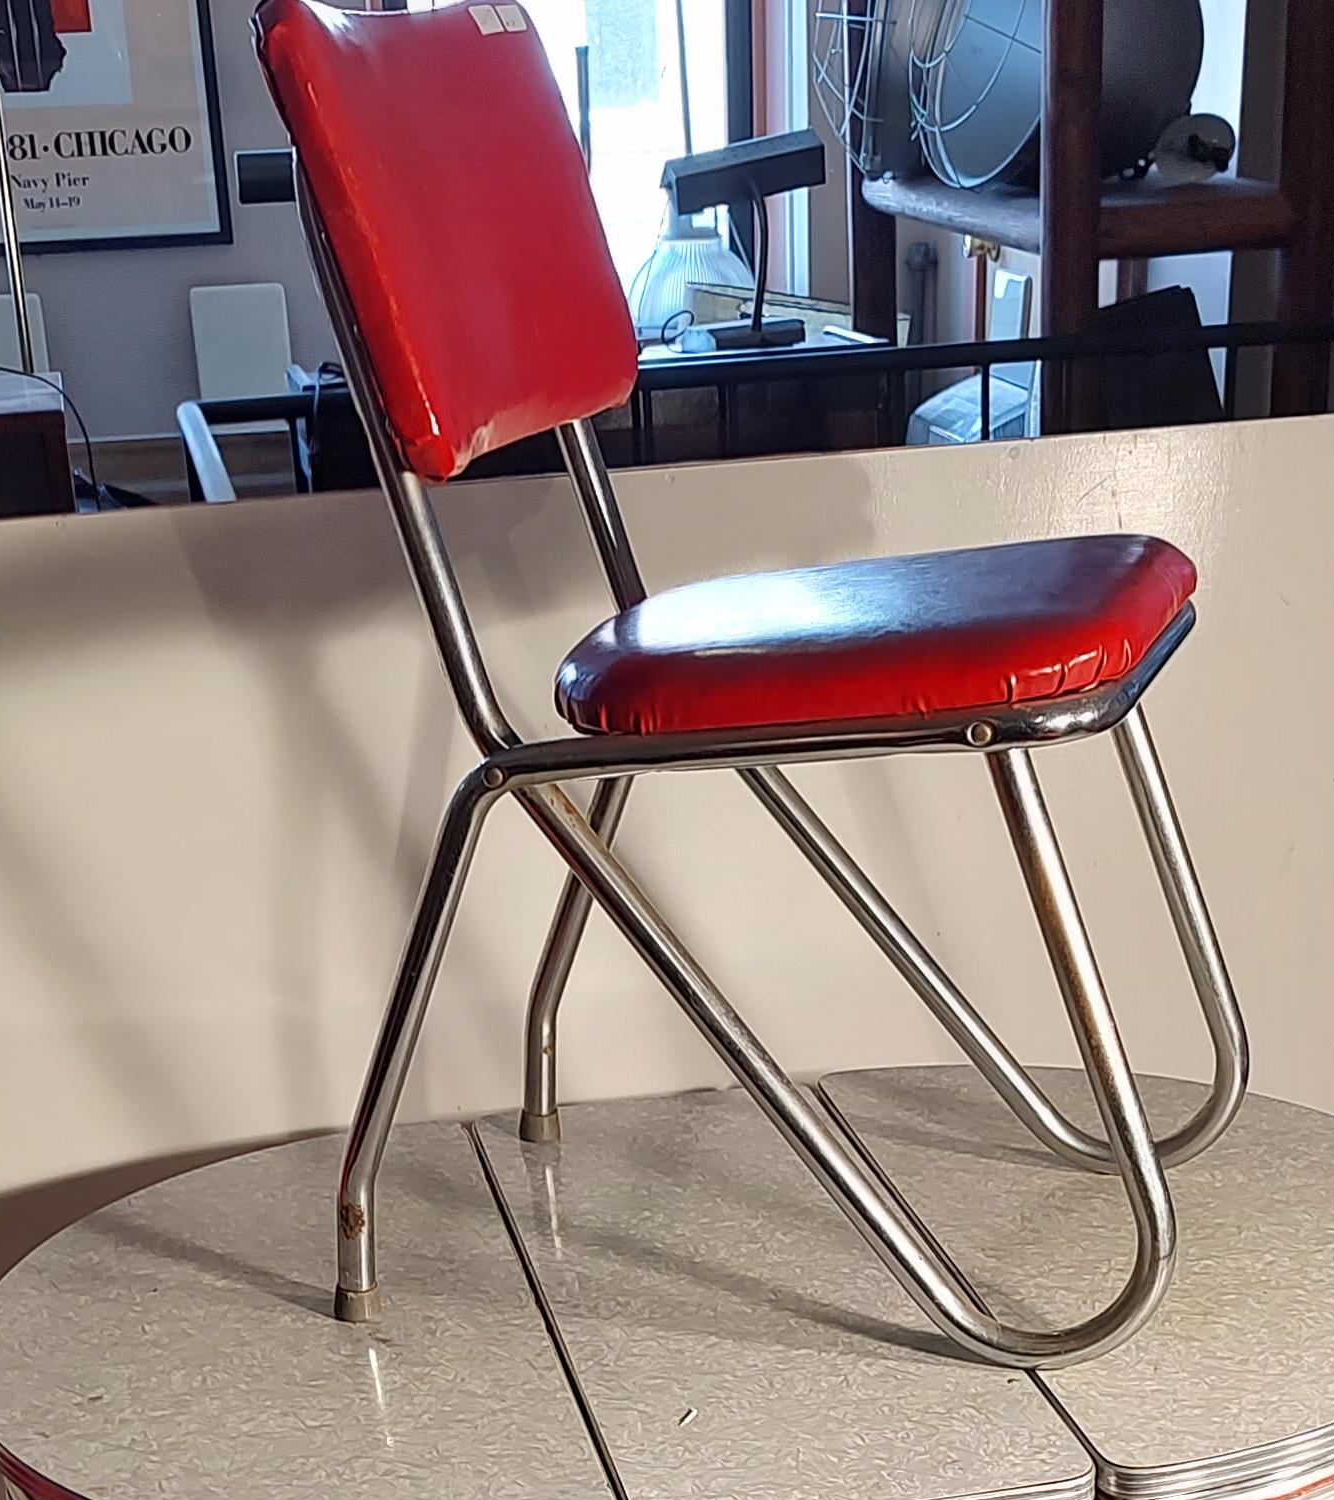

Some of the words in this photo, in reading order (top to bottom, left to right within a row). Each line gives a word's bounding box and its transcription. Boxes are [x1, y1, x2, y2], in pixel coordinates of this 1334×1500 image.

[10, 174, 49, 193] Navy
[54, 172, 90, 188] Pier
[23, 197, 46, 213] May
